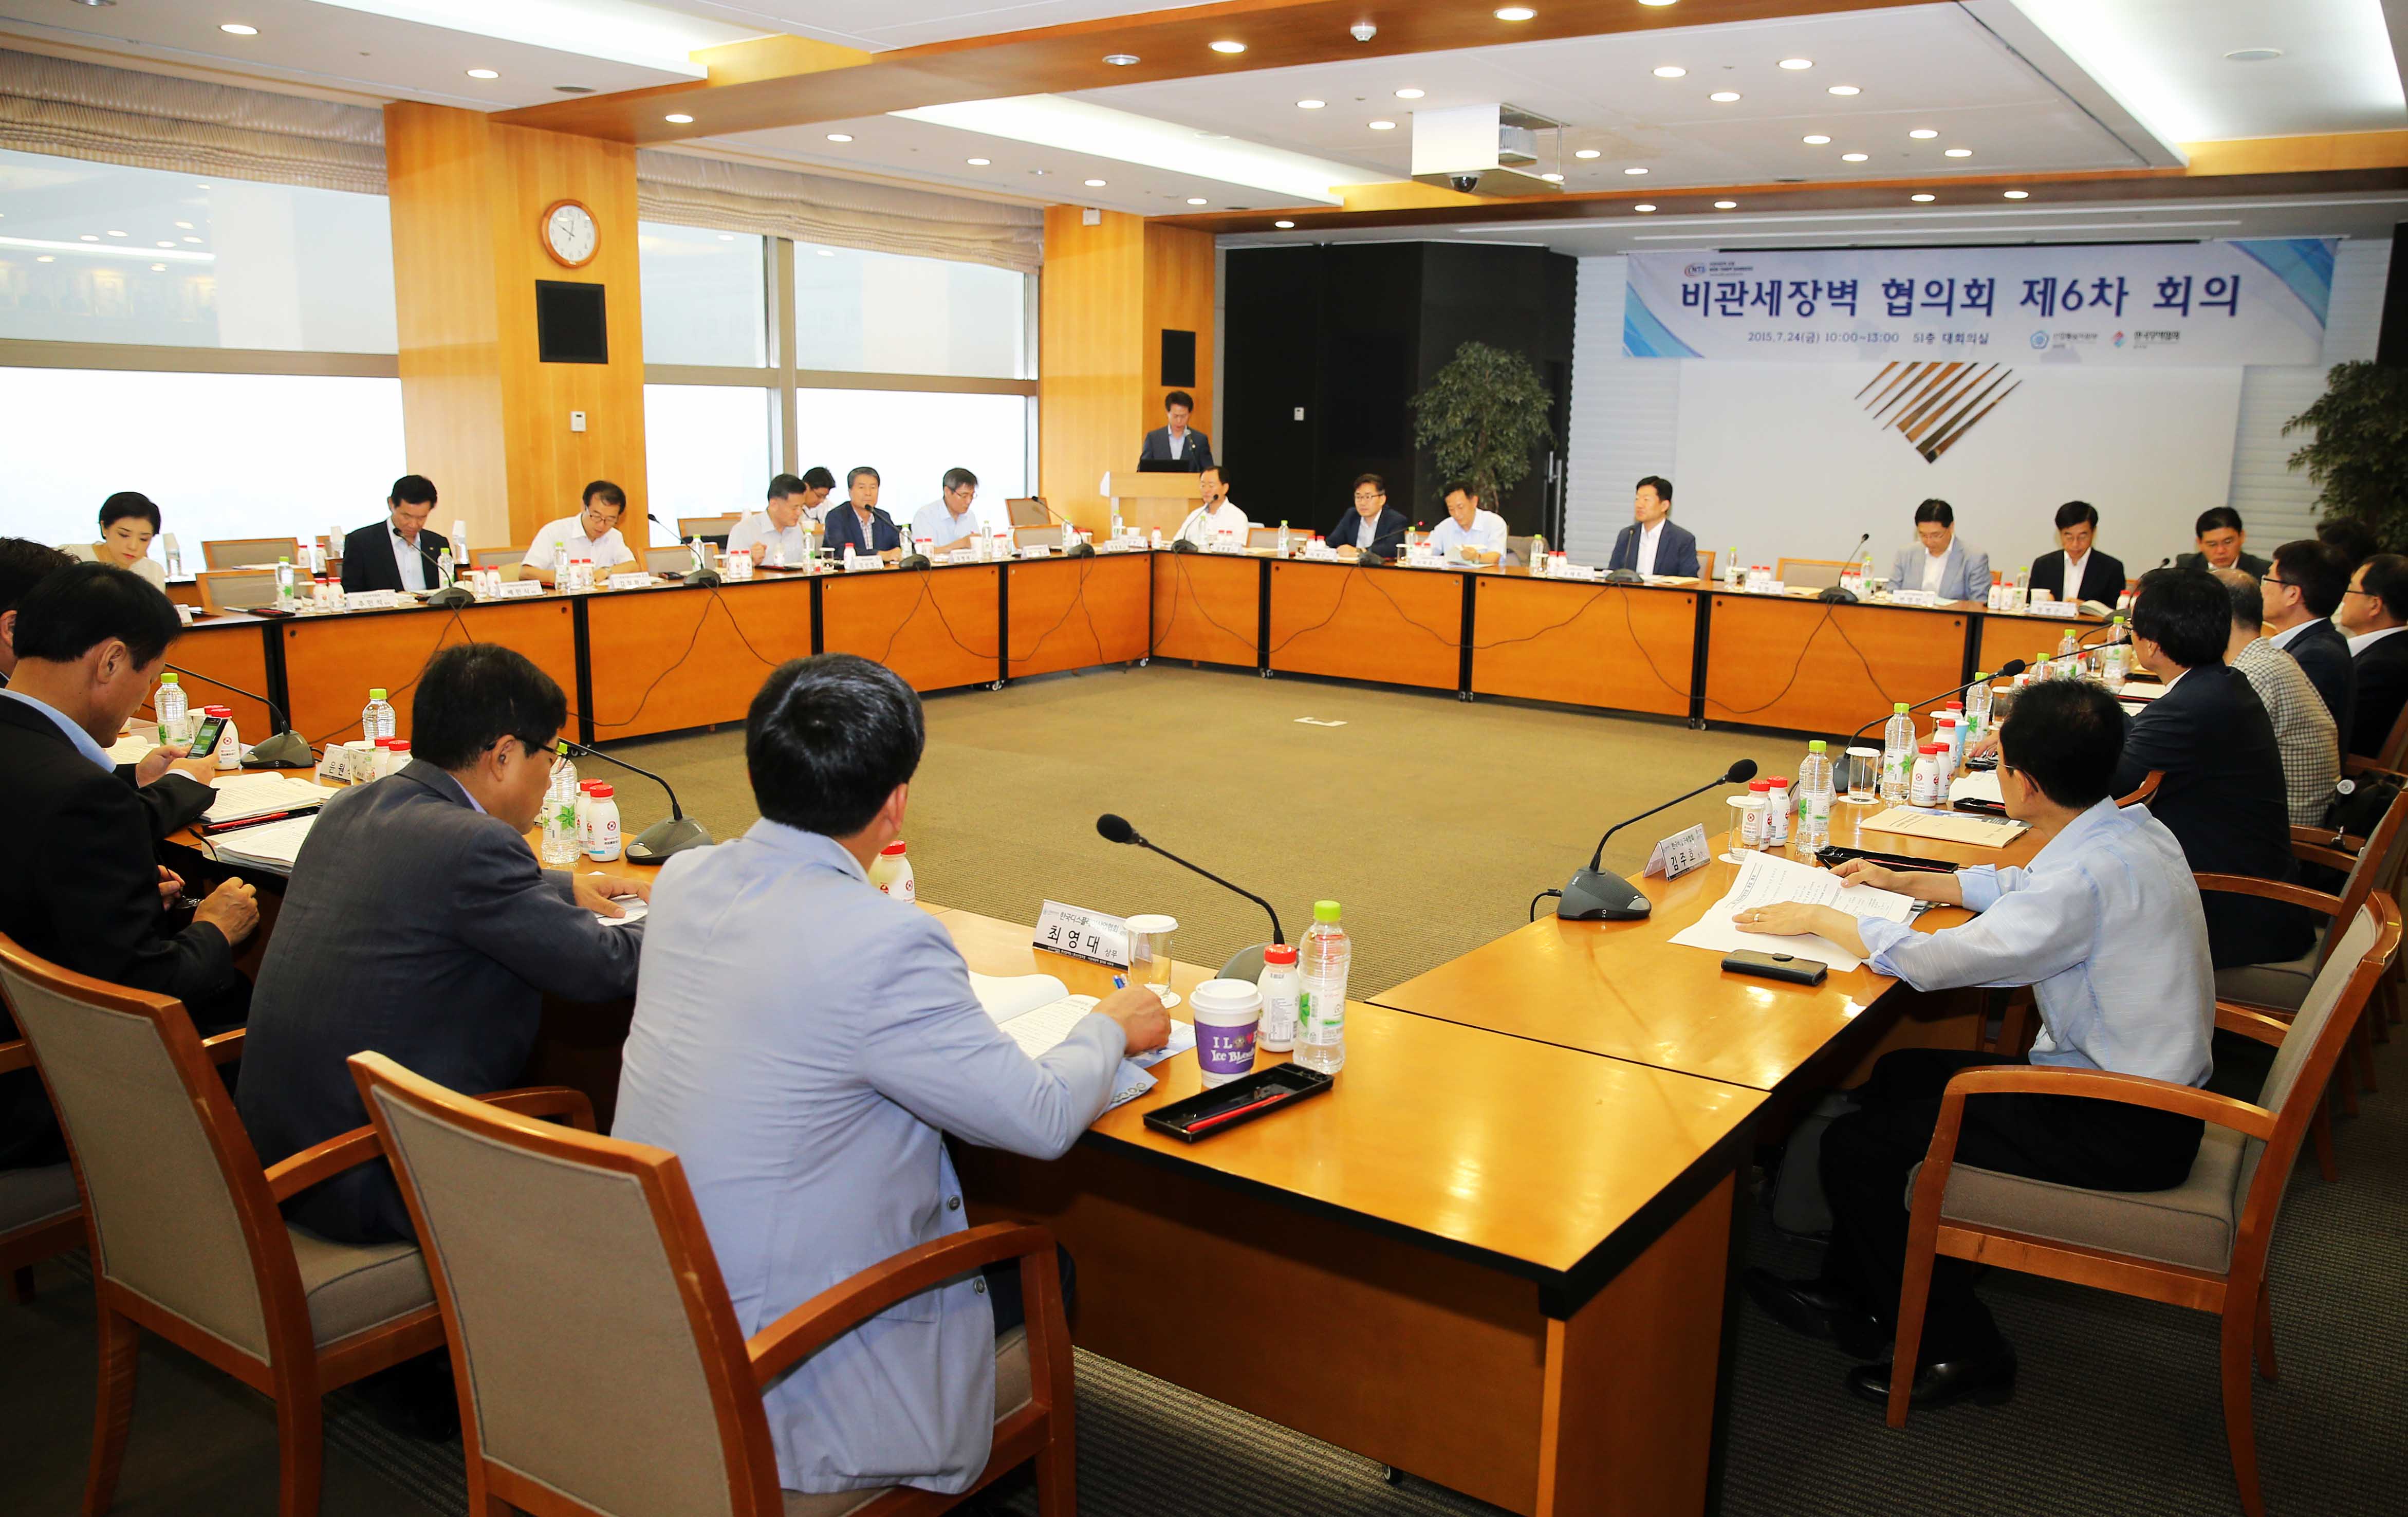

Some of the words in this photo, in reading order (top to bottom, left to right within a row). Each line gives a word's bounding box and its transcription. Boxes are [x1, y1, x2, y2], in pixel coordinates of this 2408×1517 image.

[1681, 279, 1858, 318] 비관세장벽
[1881, 277, 1995, 318] 협의회
[2019, 275, 2130, 318] 제6차
[2152, 274, 2240, 318] 회의
[1104, 948, 1118, 959] 상무
[1211, 1049, 1227, 1061] Ice
